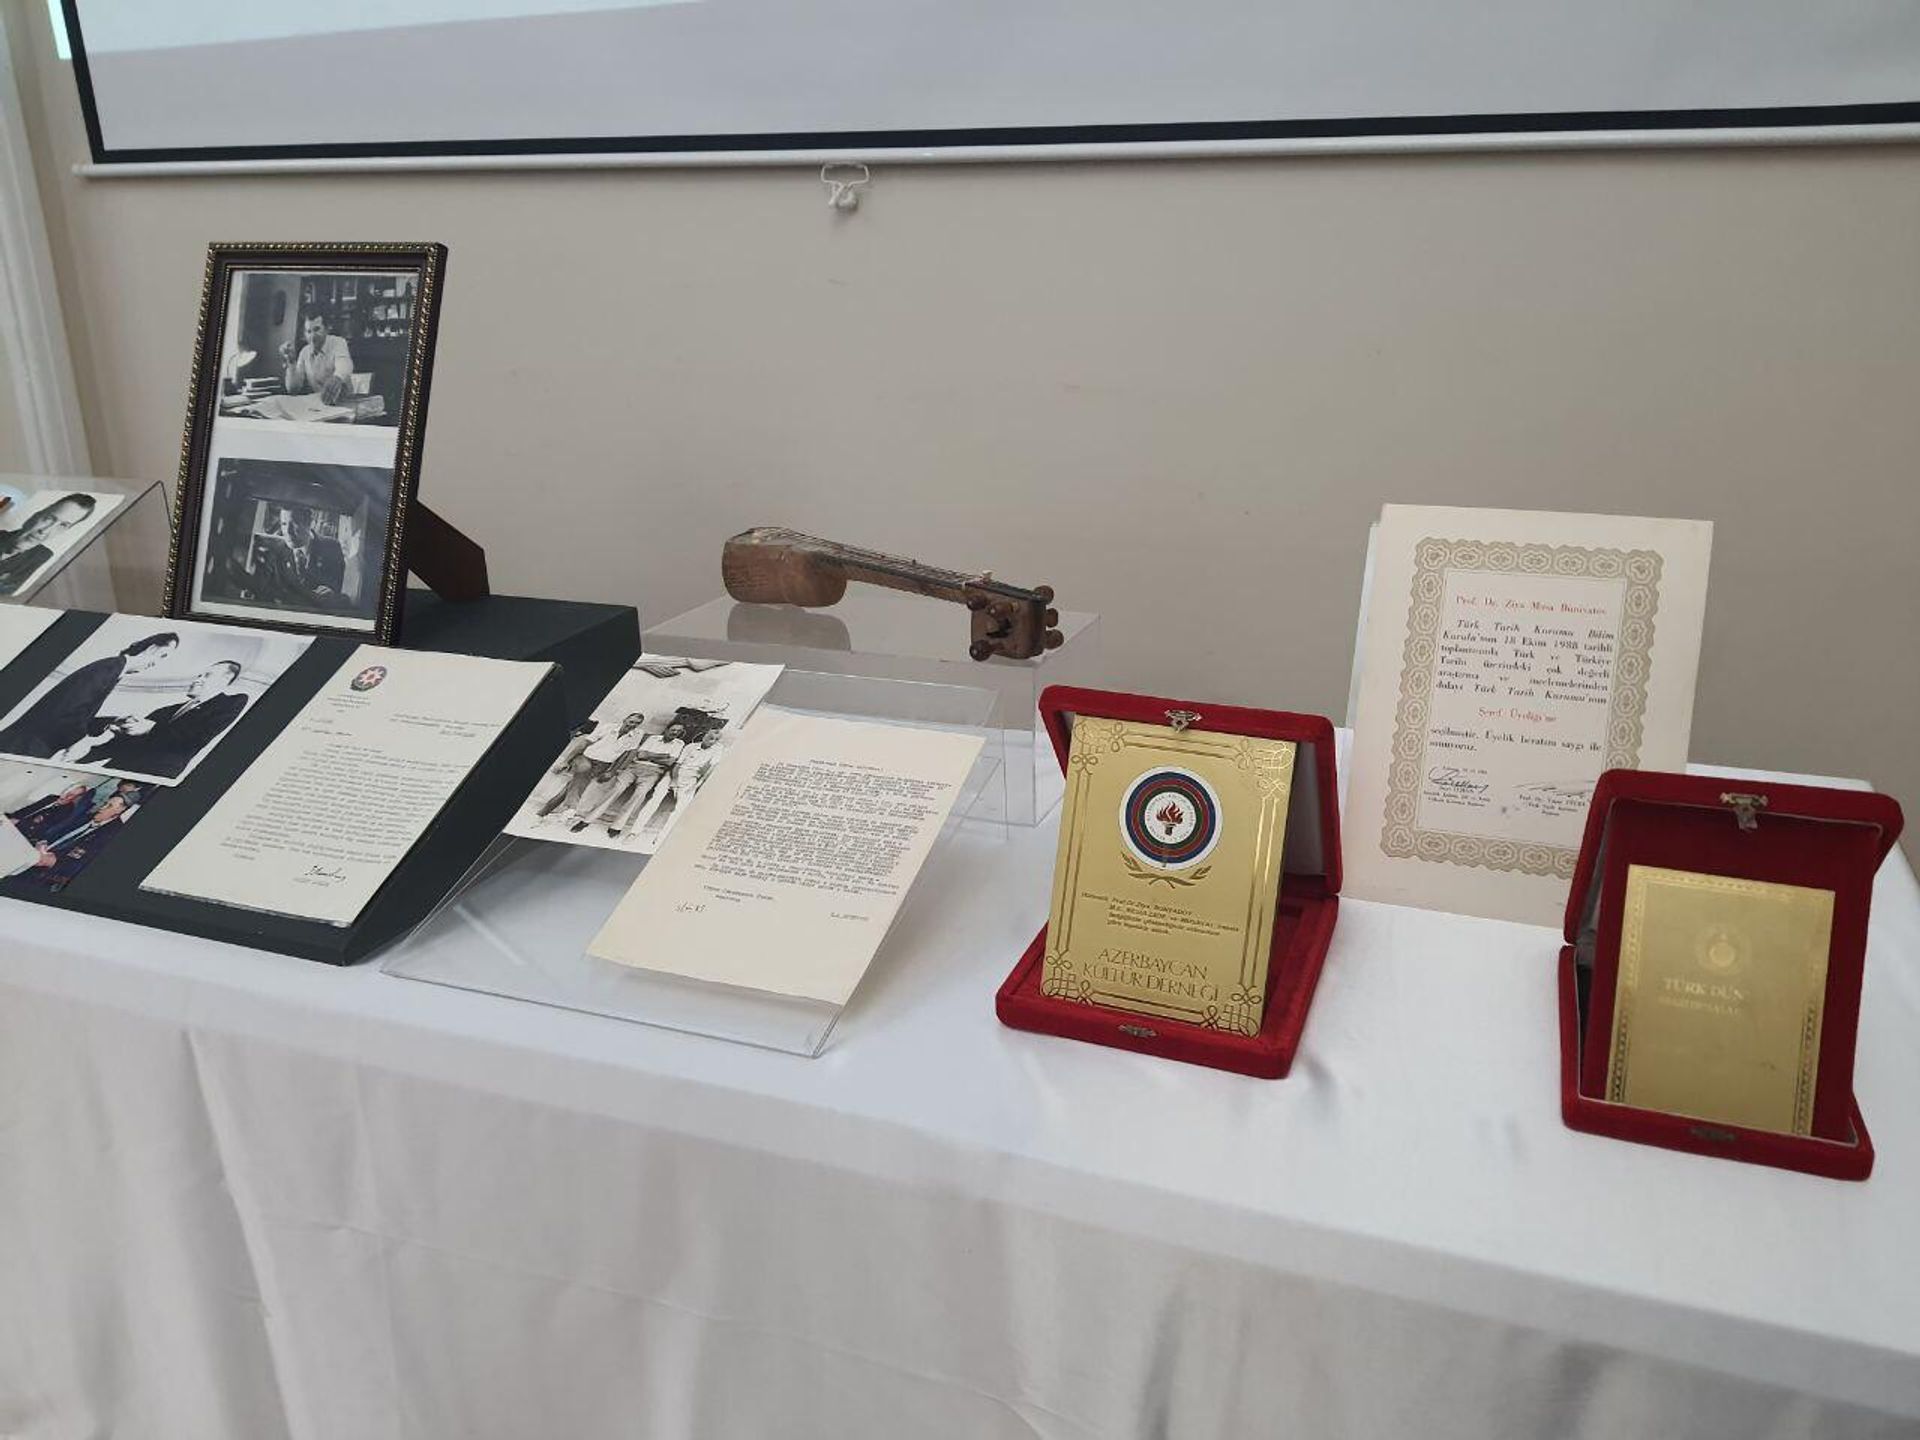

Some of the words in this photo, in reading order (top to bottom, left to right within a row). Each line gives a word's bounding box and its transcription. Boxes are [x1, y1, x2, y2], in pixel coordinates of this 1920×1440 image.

[1457, 619, 1480, 629] Türk
[1522, 637, 1547, 648] Ekim
[1554, 639, 1579, 650] 1988
[1513, 649, 1535, 660] Türk
[1474, 684, 1497, 694] Türk
[1098, 948, 1207, 980] AZERBAYCAN
